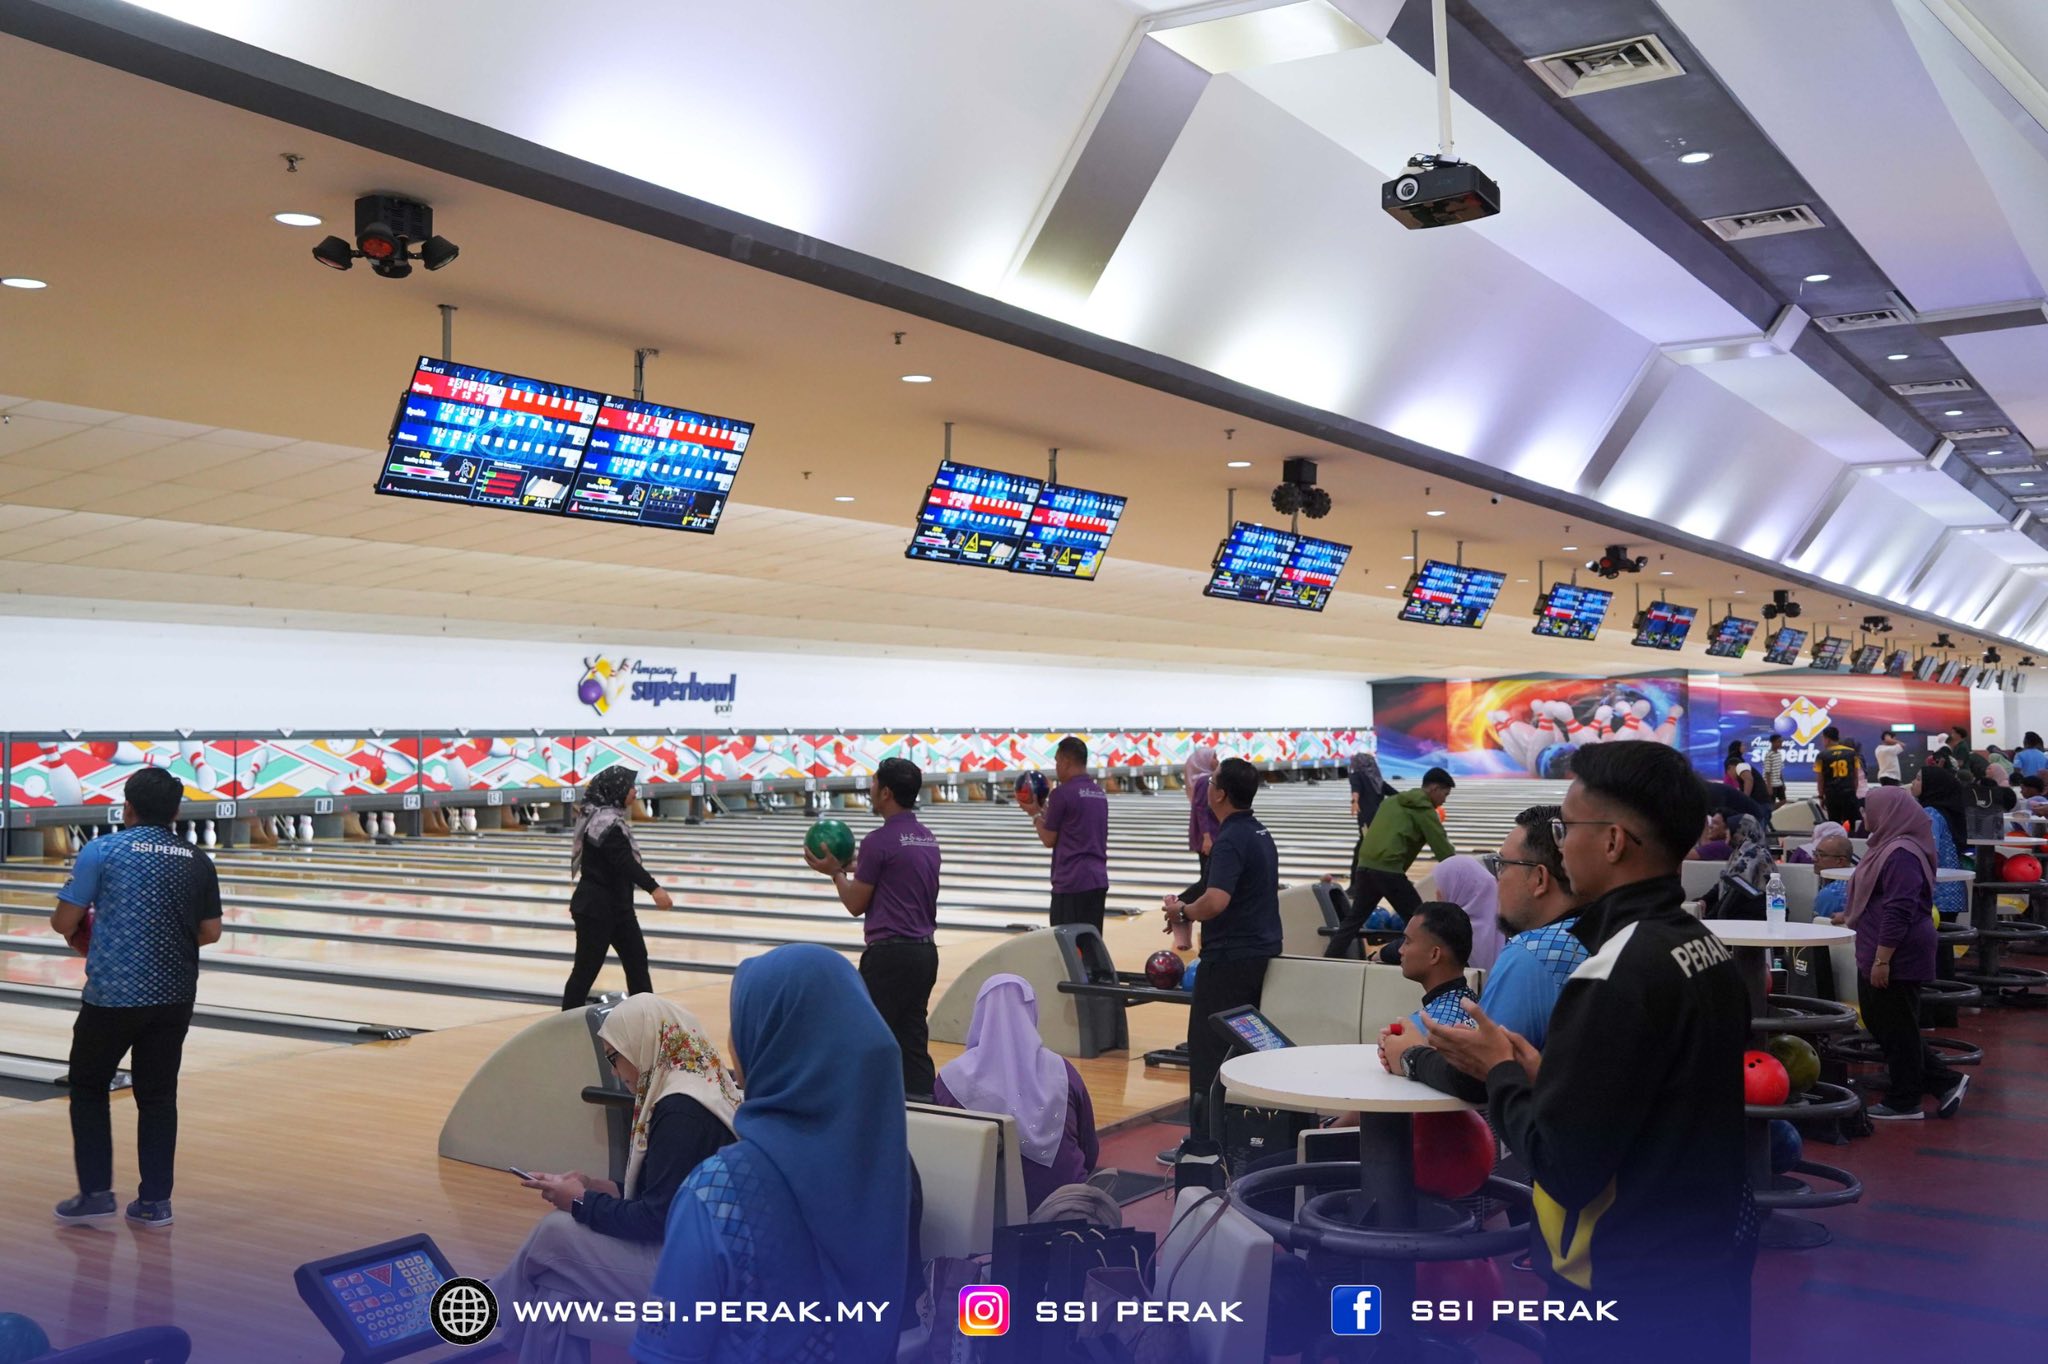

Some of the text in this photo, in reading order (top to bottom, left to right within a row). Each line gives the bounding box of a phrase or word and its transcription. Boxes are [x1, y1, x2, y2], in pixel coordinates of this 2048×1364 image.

[447, 377, 455, 386] 2
[450, 388, 456, 396] 7
[461, 390, 471, 399] 13
[584, 414, 593, 422] 39
[737, 441, 745, 449] 63
[522, 495, 553, 508] 9 25.1
[691, 518, 707, 527] 21.6
[631, 660, 677, 681] Ampang
[631, 672, 737, 707] superbowl
[1829, 759, 1848, 777] 18
[320, 801, 328, 811] 11
[408, 796, 417, 807] 12
[220, 804, 231, 815] 10
[131, 842, 194, 858] SSI PERAK
